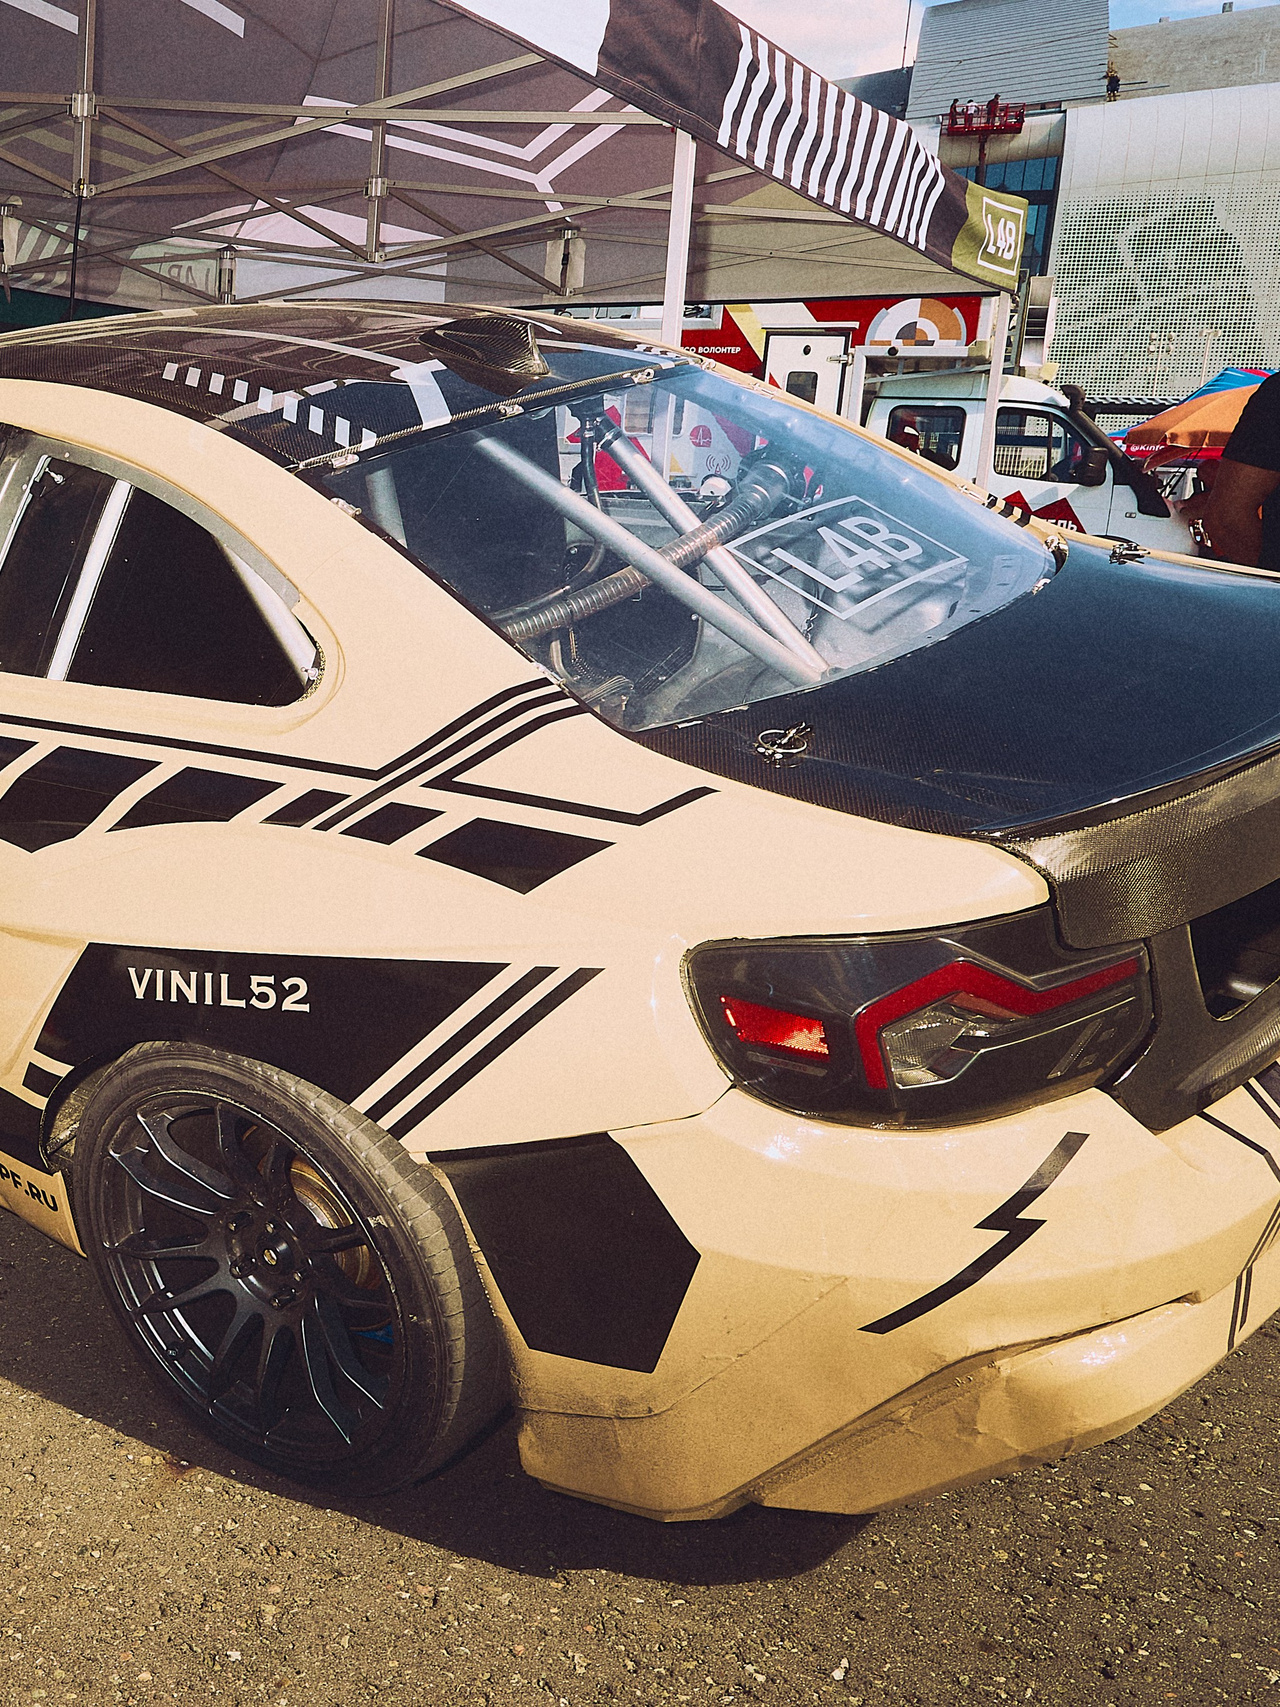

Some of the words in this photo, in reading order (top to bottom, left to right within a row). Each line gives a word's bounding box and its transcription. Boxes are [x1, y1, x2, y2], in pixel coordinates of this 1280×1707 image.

[986, 213, 1016, 260] L4B
[698, 346, 741, 354] ВОЛОНТЕР
[770, 516, 923, 593] L4B
[127, 966, 310, 1013] VINIL52
